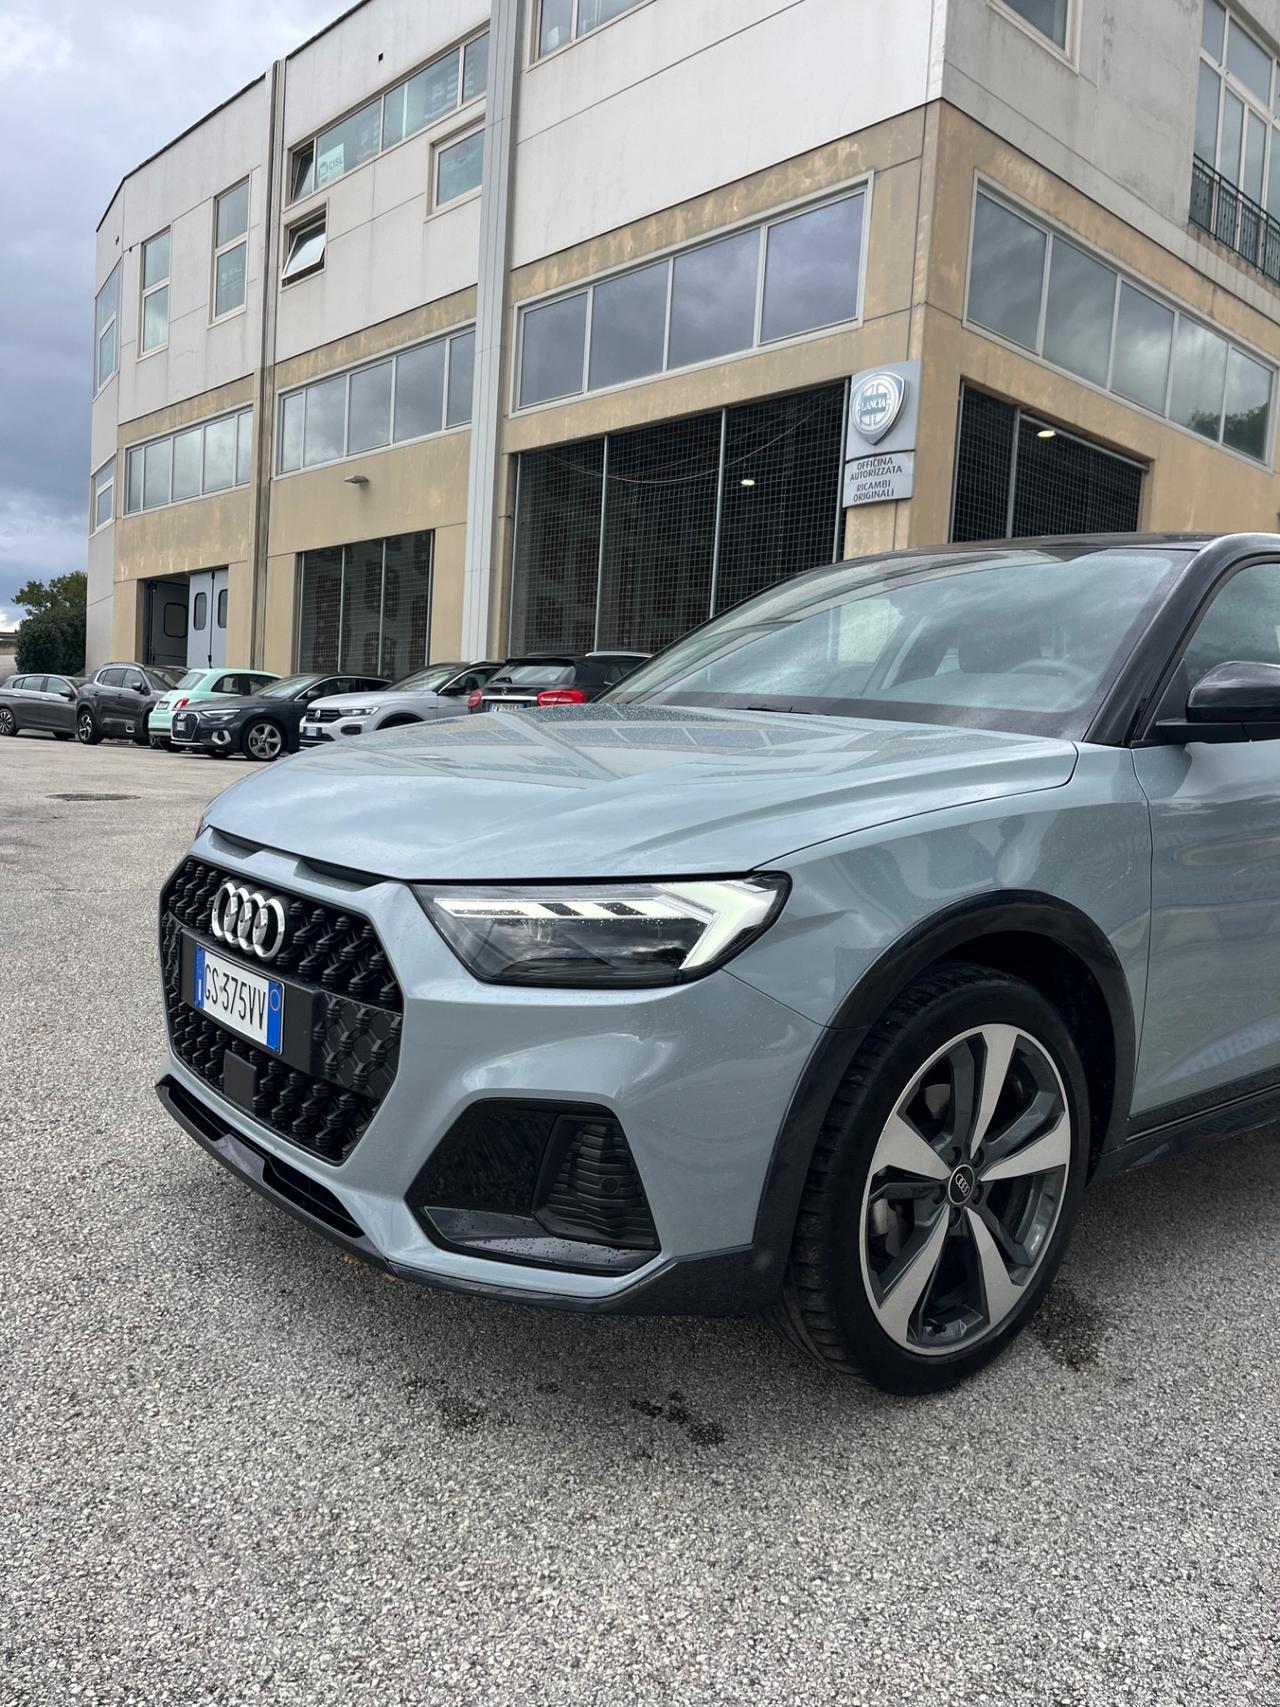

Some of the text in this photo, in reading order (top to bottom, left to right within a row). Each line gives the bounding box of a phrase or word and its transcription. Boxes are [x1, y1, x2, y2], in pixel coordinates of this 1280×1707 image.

[861, 397, 886, 411] LANCIA
[857, 457, 893, 470] OFFICINA
[850, 465, 902, 482] AUTORIZZATA
[857, 479, 891, 492] RICAMBI
[853, 488, 894, 502] ORIGINALI
